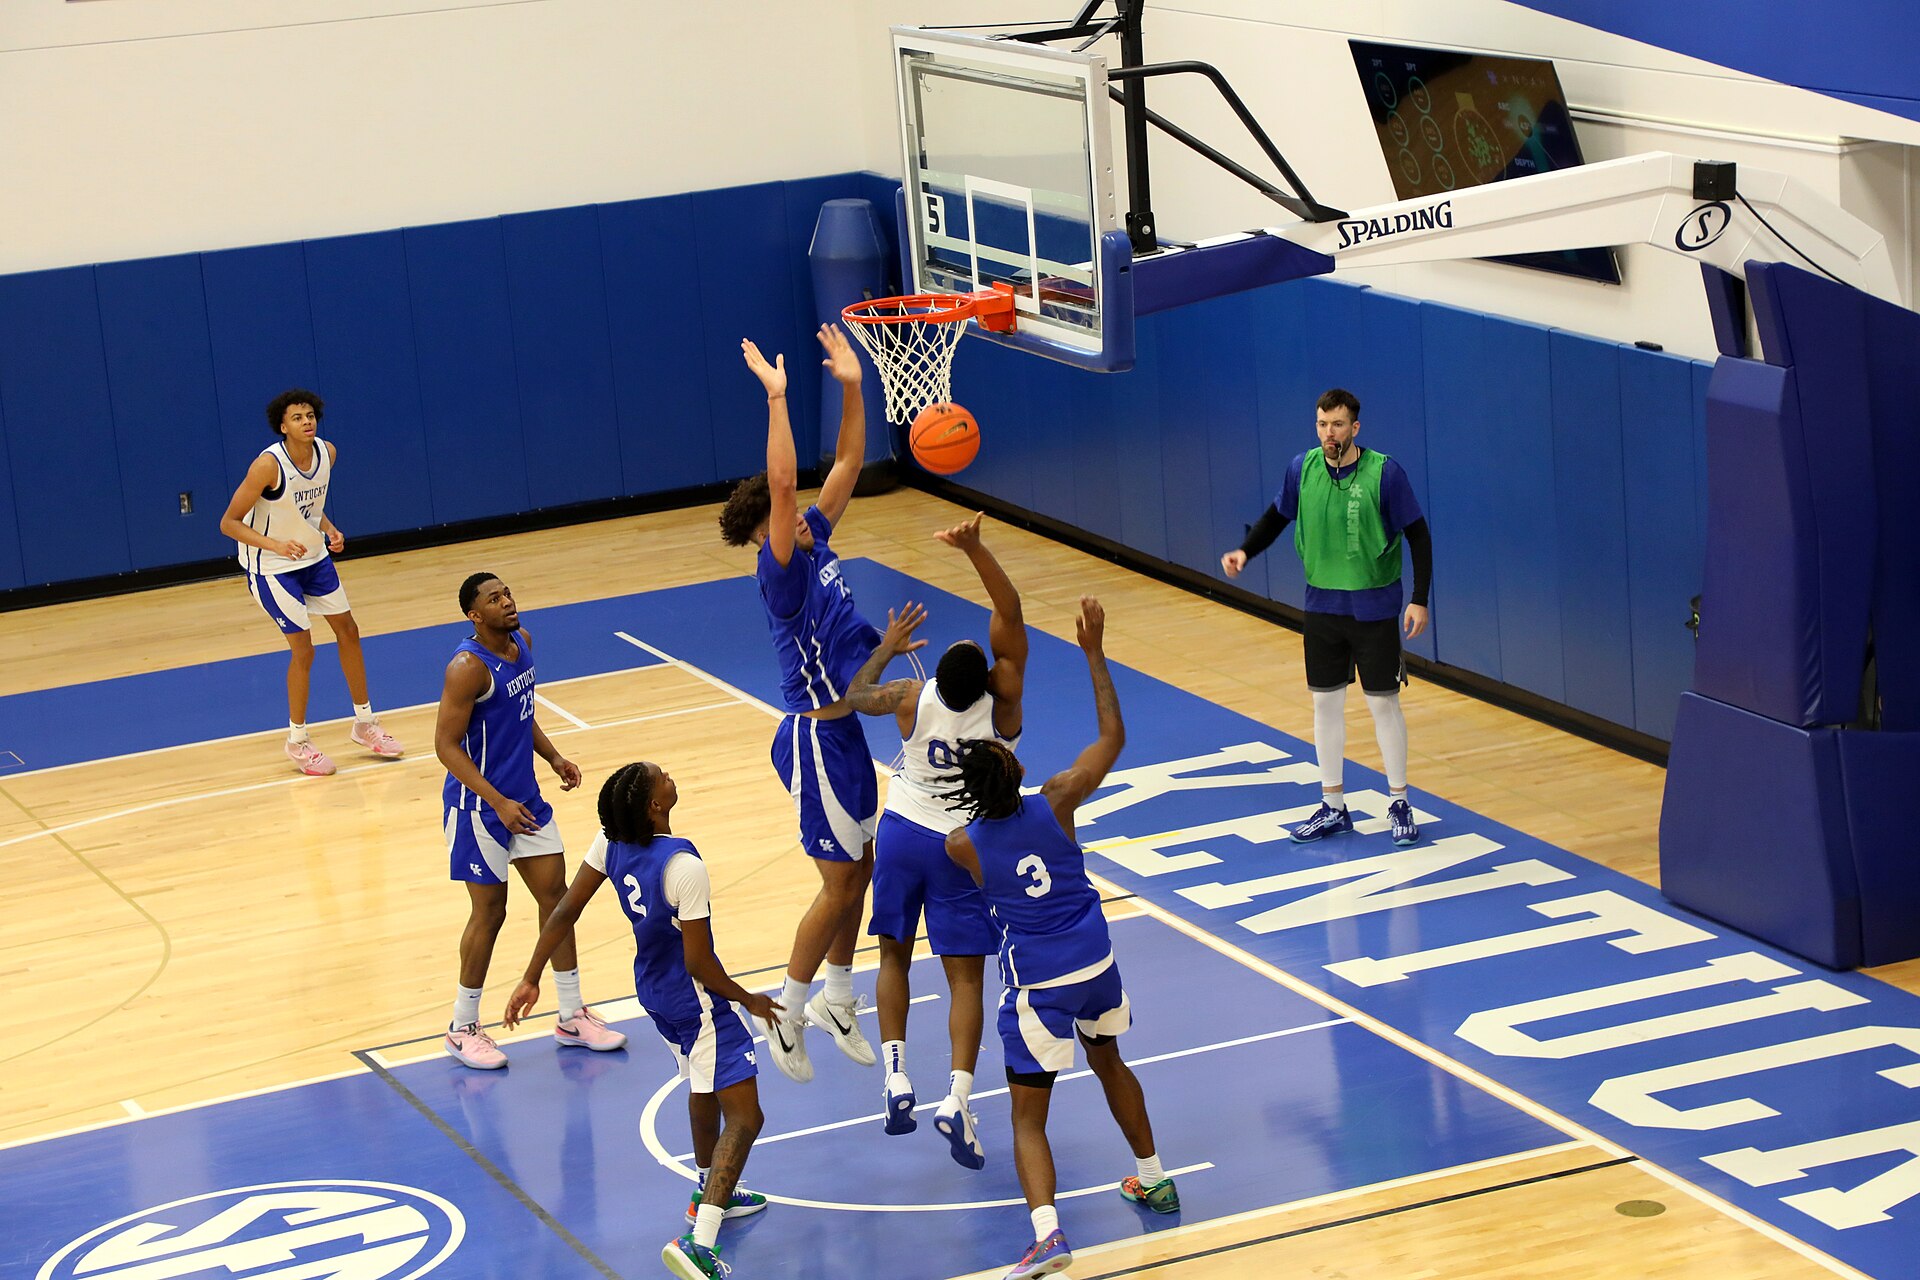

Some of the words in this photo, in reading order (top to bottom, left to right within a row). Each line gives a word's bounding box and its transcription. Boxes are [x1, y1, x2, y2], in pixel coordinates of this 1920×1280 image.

[1514, 157, 1535, 168] DEPTH
[926, 196, 940, 234] 5
[1337, 200, 1453, 250] SPALDING
[293, 484, 327, 505] ENTUCKY
[506, 665, 536, 698] KENTUCK
[520, 689, 534, 721] 23
[1015, 853, 1052, 898] 3
[623, 873, 647, 918] 2
